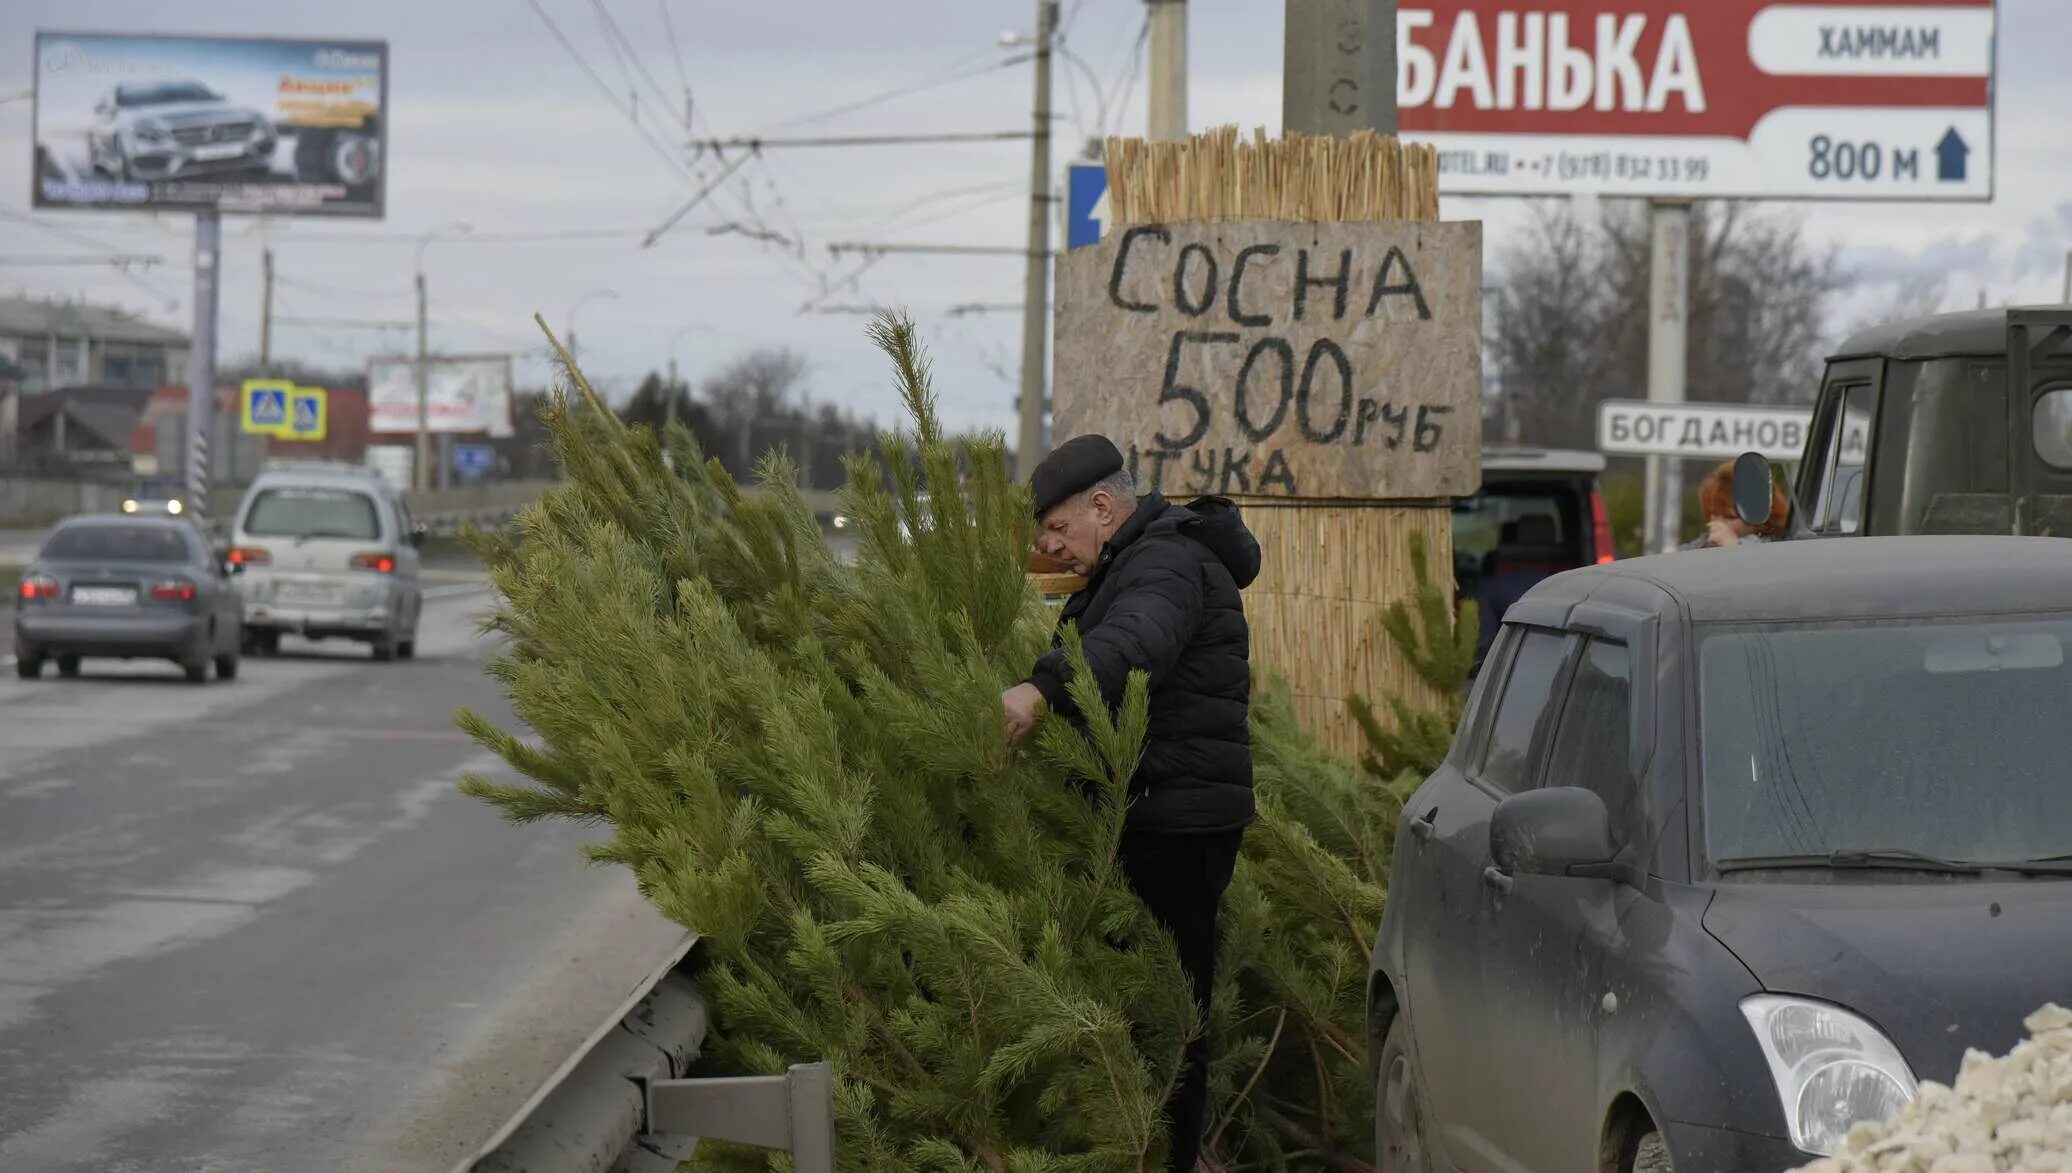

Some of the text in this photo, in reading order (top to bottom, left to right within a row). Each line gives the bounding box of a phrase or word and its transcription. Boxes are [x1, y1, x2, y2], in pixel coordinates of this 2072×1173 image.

[1397, 9, 1707, 113] БАНЬКА
[1817, 25, 1940, 60] ХАММАМ
[1438, 150, 1510, 177] OTEL.RU
[1657, 156, 1680, 181] 33
[1808, 135, 1882, 182] 800
[1109, 224, 1432, 327] СОСНА
[1154, 330, 1352, 450] 500
[1610, 414, 1864, 455] БОГДАНОВА
[1128, 444, 1297, 496] ТУКА
